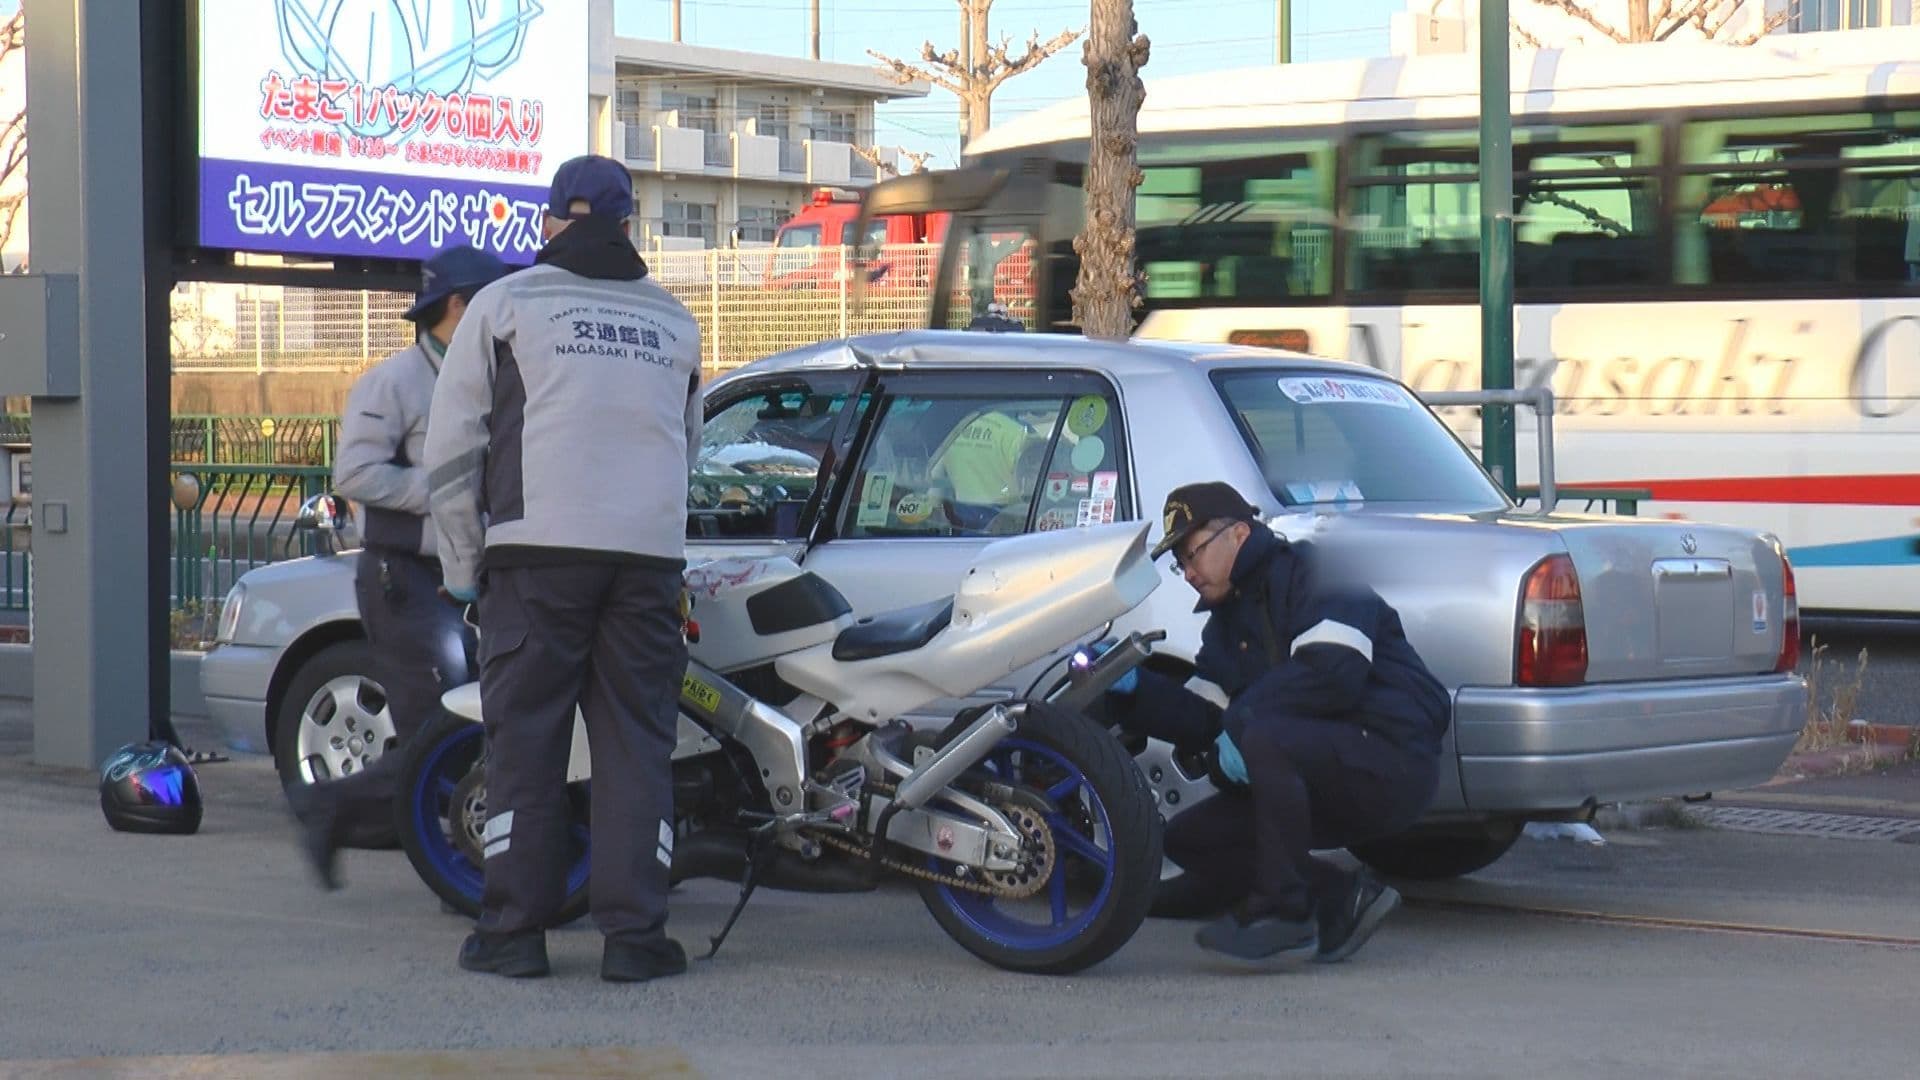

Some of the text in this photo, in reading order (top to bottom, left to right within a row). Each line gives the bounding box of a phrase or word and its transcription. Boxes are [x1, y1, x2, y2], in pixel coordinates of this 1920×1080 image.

[229, 174, 457, 247] セルフスタンド
[572, 319, 660, 350] 交通鑑識
[556, 343, 674, 368] NAGASAKI POLICE
